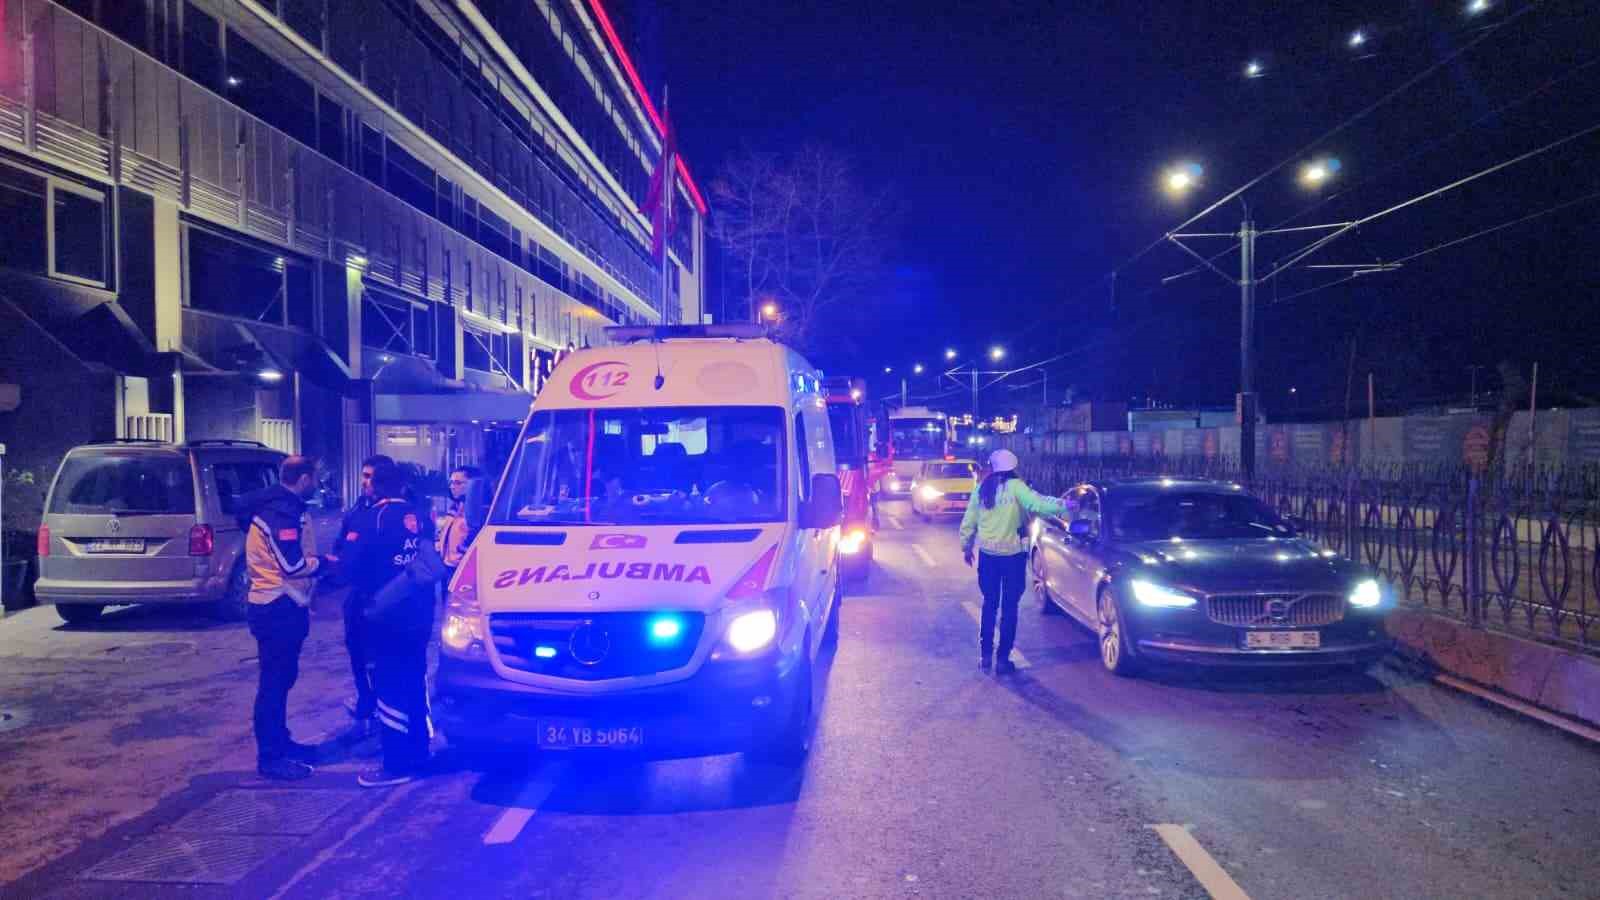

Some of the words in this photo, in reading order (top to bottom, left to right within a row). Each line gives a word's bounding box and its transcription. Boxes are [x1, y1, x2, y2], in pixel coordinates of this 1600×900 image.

[587, 371, 629, 387] 112
[546, 727, 567, 744] 34
[572, 727, 592, 744] YB
